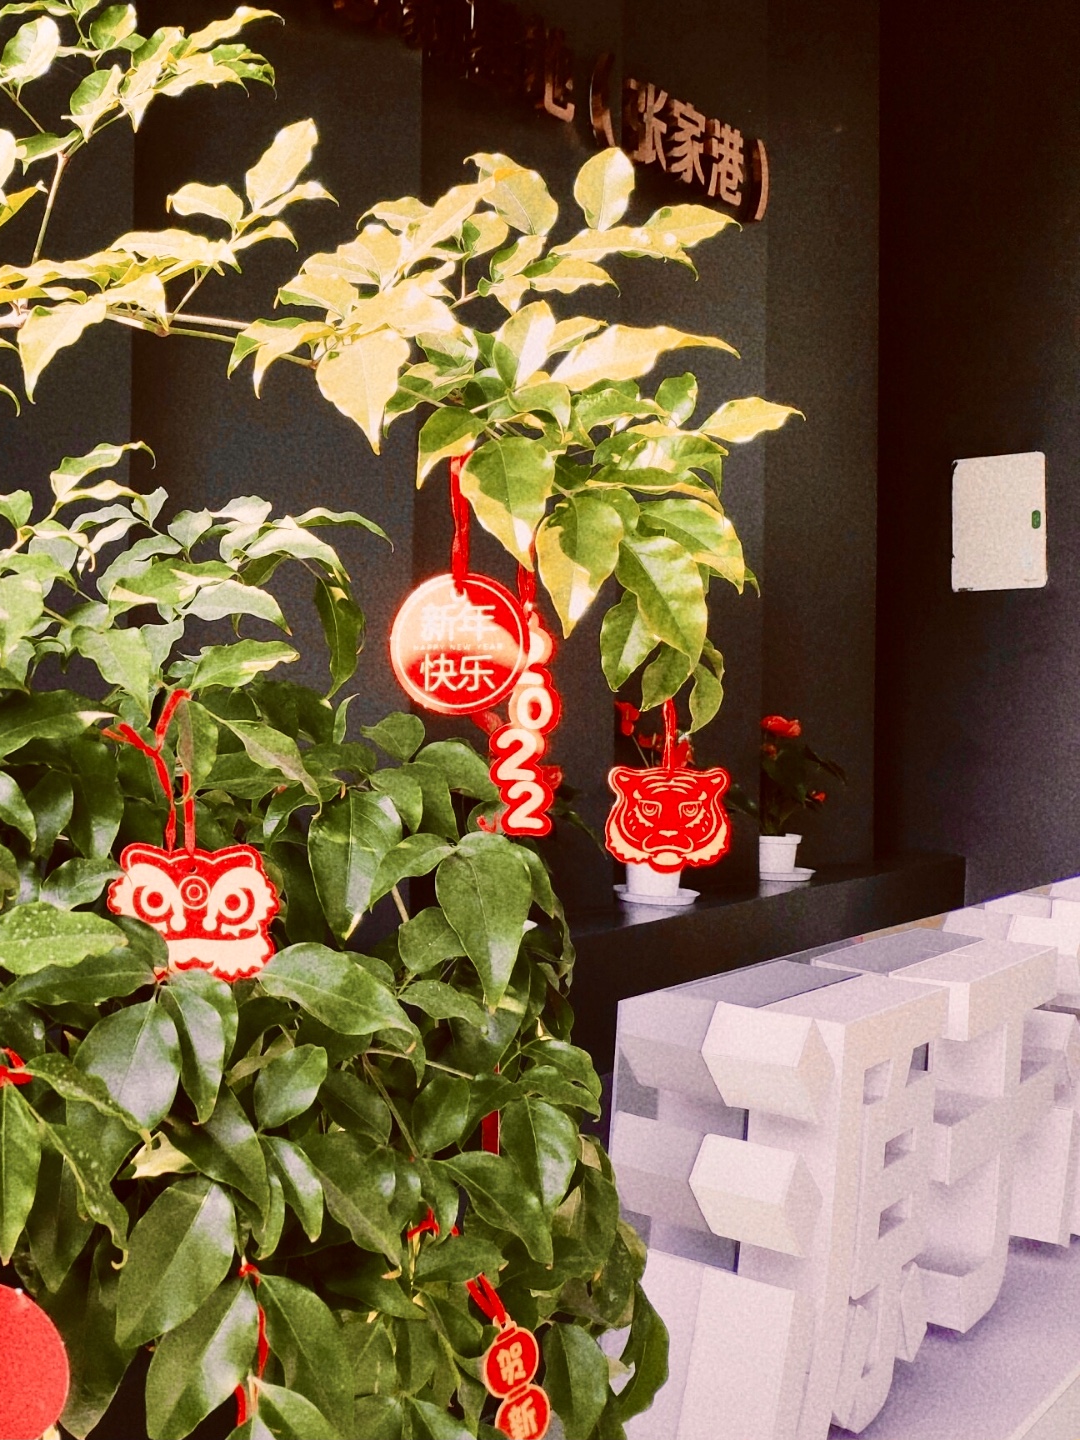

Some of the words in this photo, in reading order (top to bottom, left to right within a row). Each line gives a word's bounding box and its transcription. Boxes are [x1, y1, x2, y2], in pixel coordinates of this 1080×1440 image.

[421, 603, 498, 642] 新年
[413, 643, 446, 651] HAPPY
[449, 643, 471, 651] NEW
[477, 642, 504, 651] YEAR
[420, 653, 496, 692] 快乐
